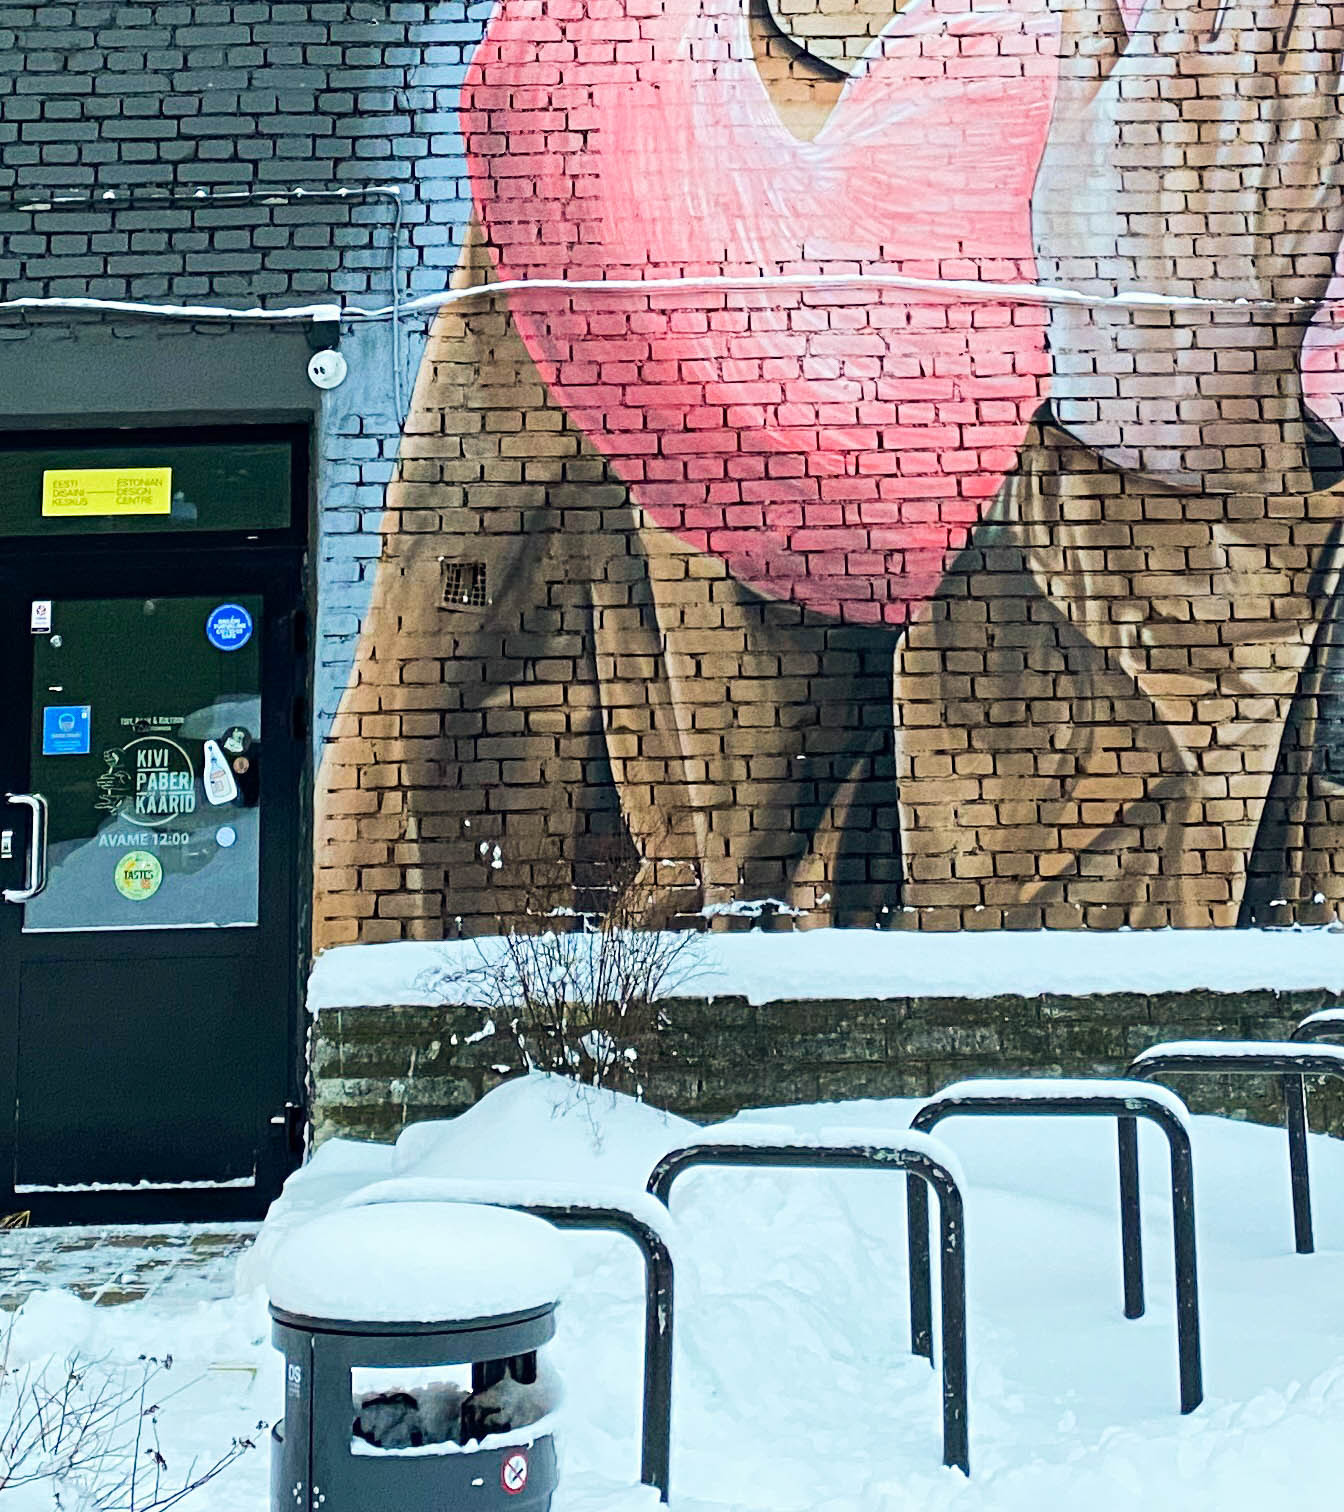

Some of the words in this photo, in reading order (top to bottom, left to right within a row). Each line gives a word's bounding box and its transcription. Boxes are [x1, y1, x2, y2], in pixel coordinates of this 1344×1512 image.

[52, 479, 79, 488] EESTI
[117, 478, 163, 488] ESTONIAN
[52, 488, 86, 498] DISAINI
[116, 488, 152, 496] DESIGN
[116, 496, 153, 505] CENTRE
[136, 748, 169, 768] KIVI
[136, 771, 190, 791] PABER
[99, 832, 149, 847] AVAME
[153, 831, 190, 845] 12:00
